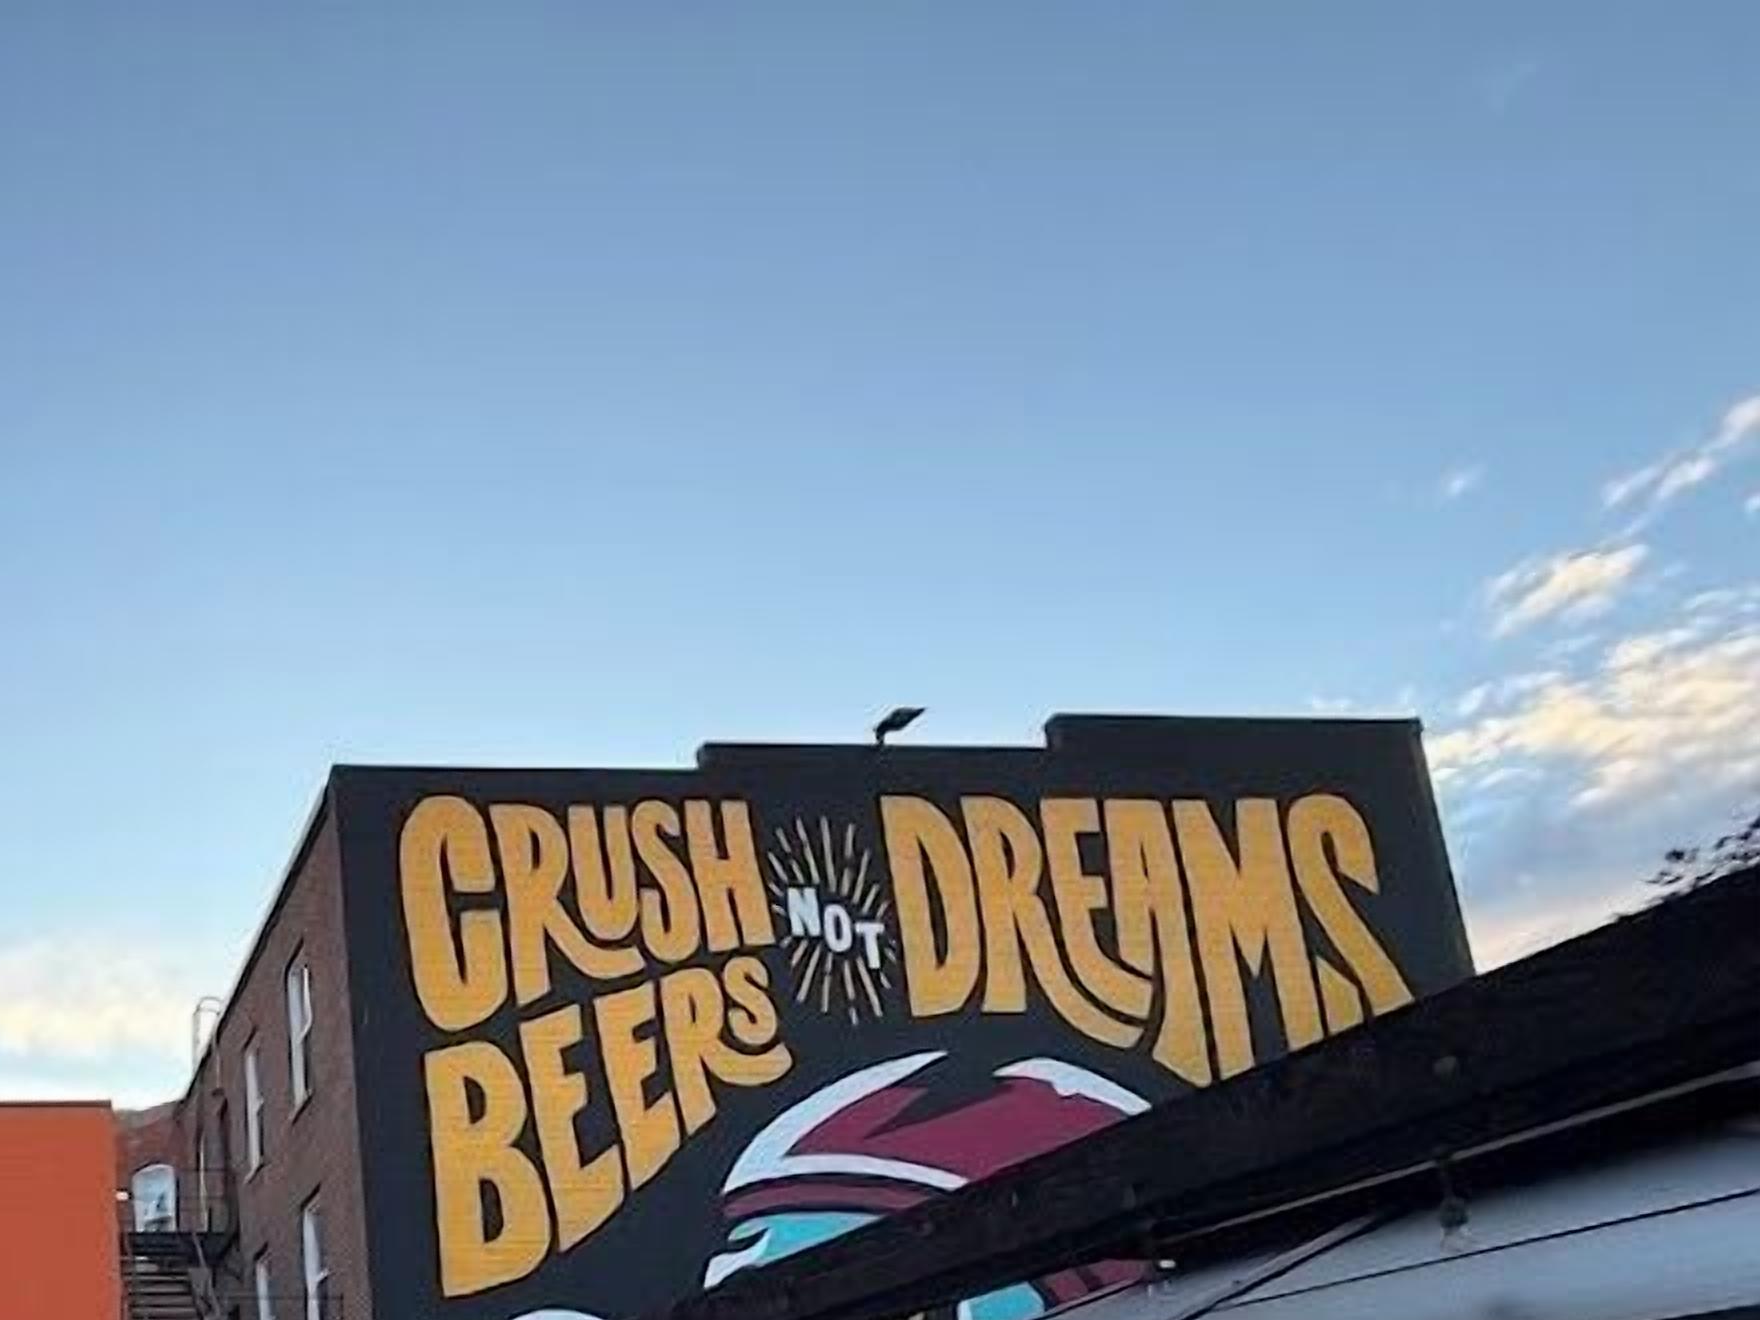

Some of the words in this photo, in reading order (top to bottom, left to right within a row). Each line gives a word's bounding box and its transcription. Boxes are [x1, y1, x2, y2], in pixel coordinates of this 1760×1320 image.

[399, 794, 776, 1032] CRUSH
[785, 885, 888, 970] NOT
[880, 792, 1415, 1087] DREAMS
[423, 954, 794, 1297] BEERS
